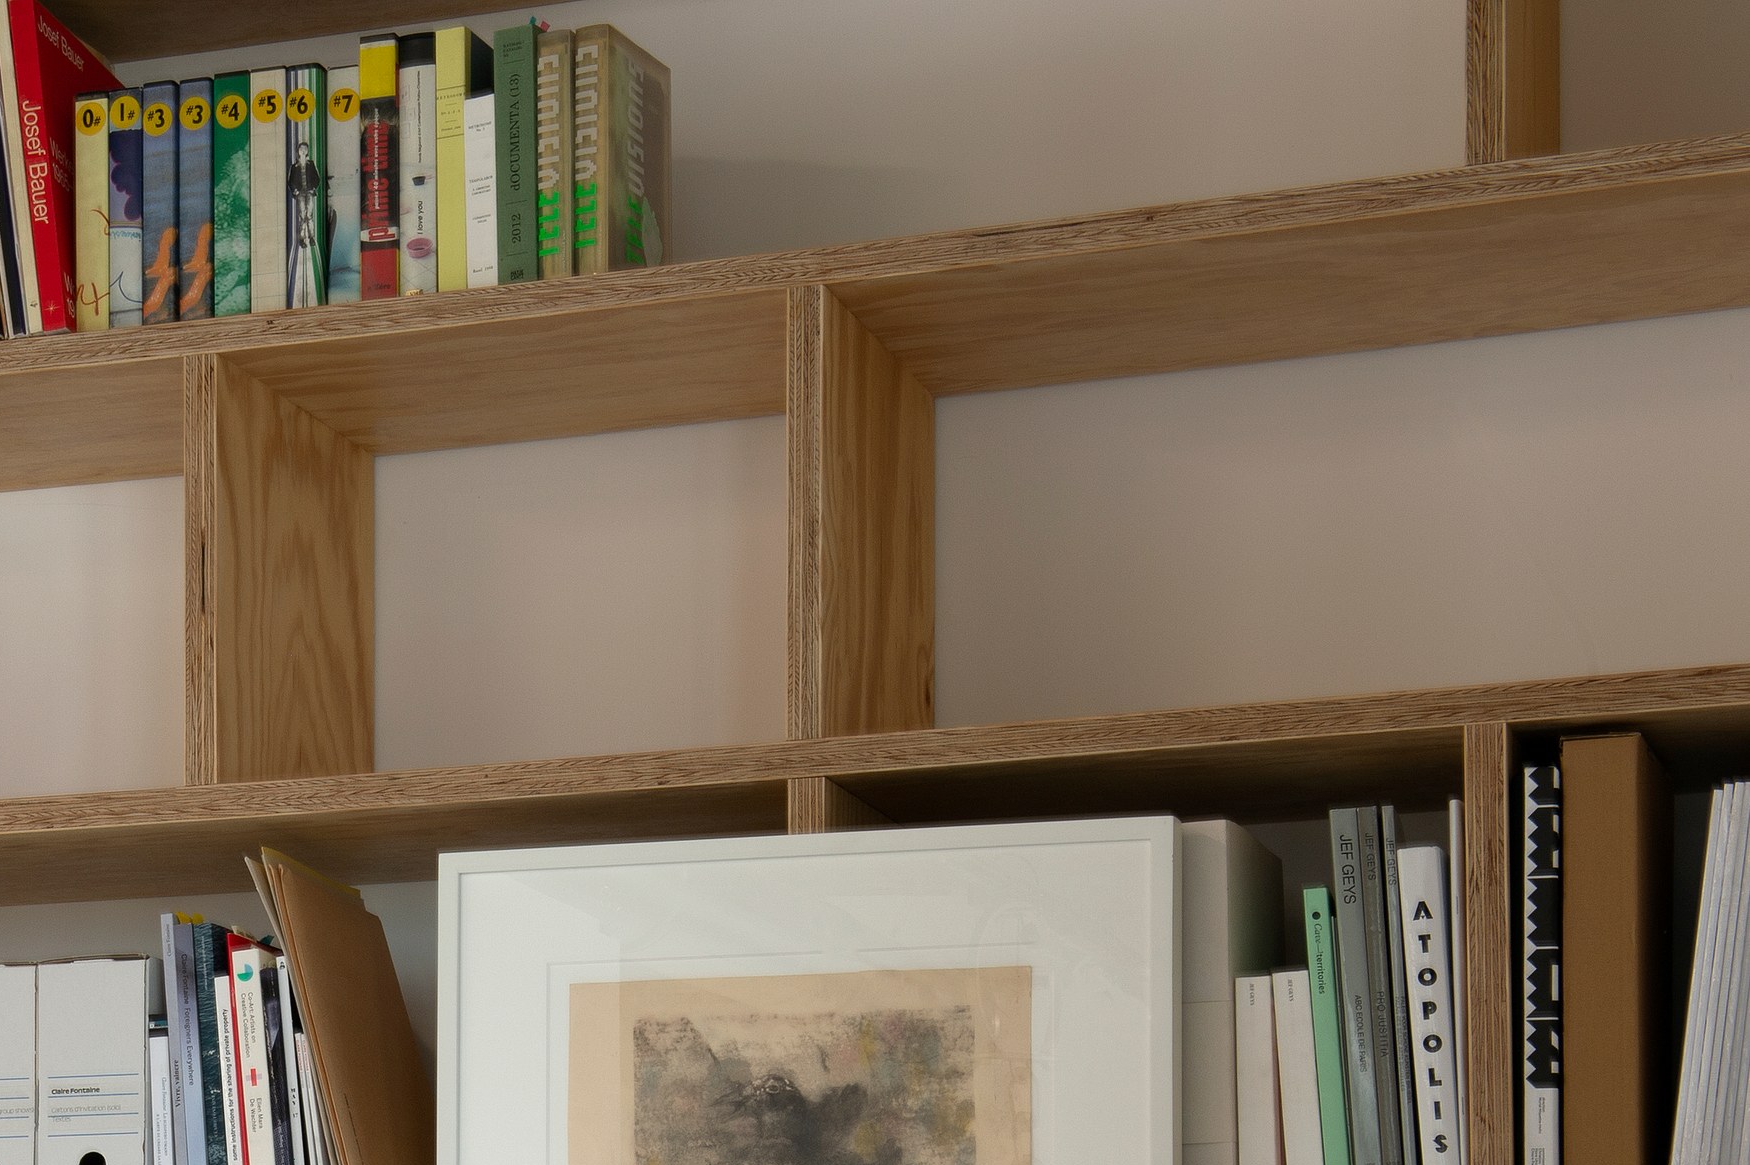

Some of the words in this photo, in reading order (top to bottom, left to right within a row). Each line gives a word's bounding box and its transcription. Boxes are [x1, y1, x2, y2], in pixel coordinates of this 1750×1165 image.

[37, 15, 59, 40] Josef
[60, 38, 86, 72] Bauer
[147, 107, 165, 127] #3
[186, 104, 204, 125] #3
[221, 101, 240, 121] #4
[258, 94, 278, 115] #5
[290, 94, 309, 115] #6
[333, 93, 354, 114] #7
[22, 101, 46, 157] Josef
[29, 161, 49, 225] Bauer
[512, 213, 521, 244] 2012
[1340, 835, 1354, 862] JEF
[1342, 863, 1356, 905] GEYS
[1413, 900, 1448, 1154] ATOPOLIS
